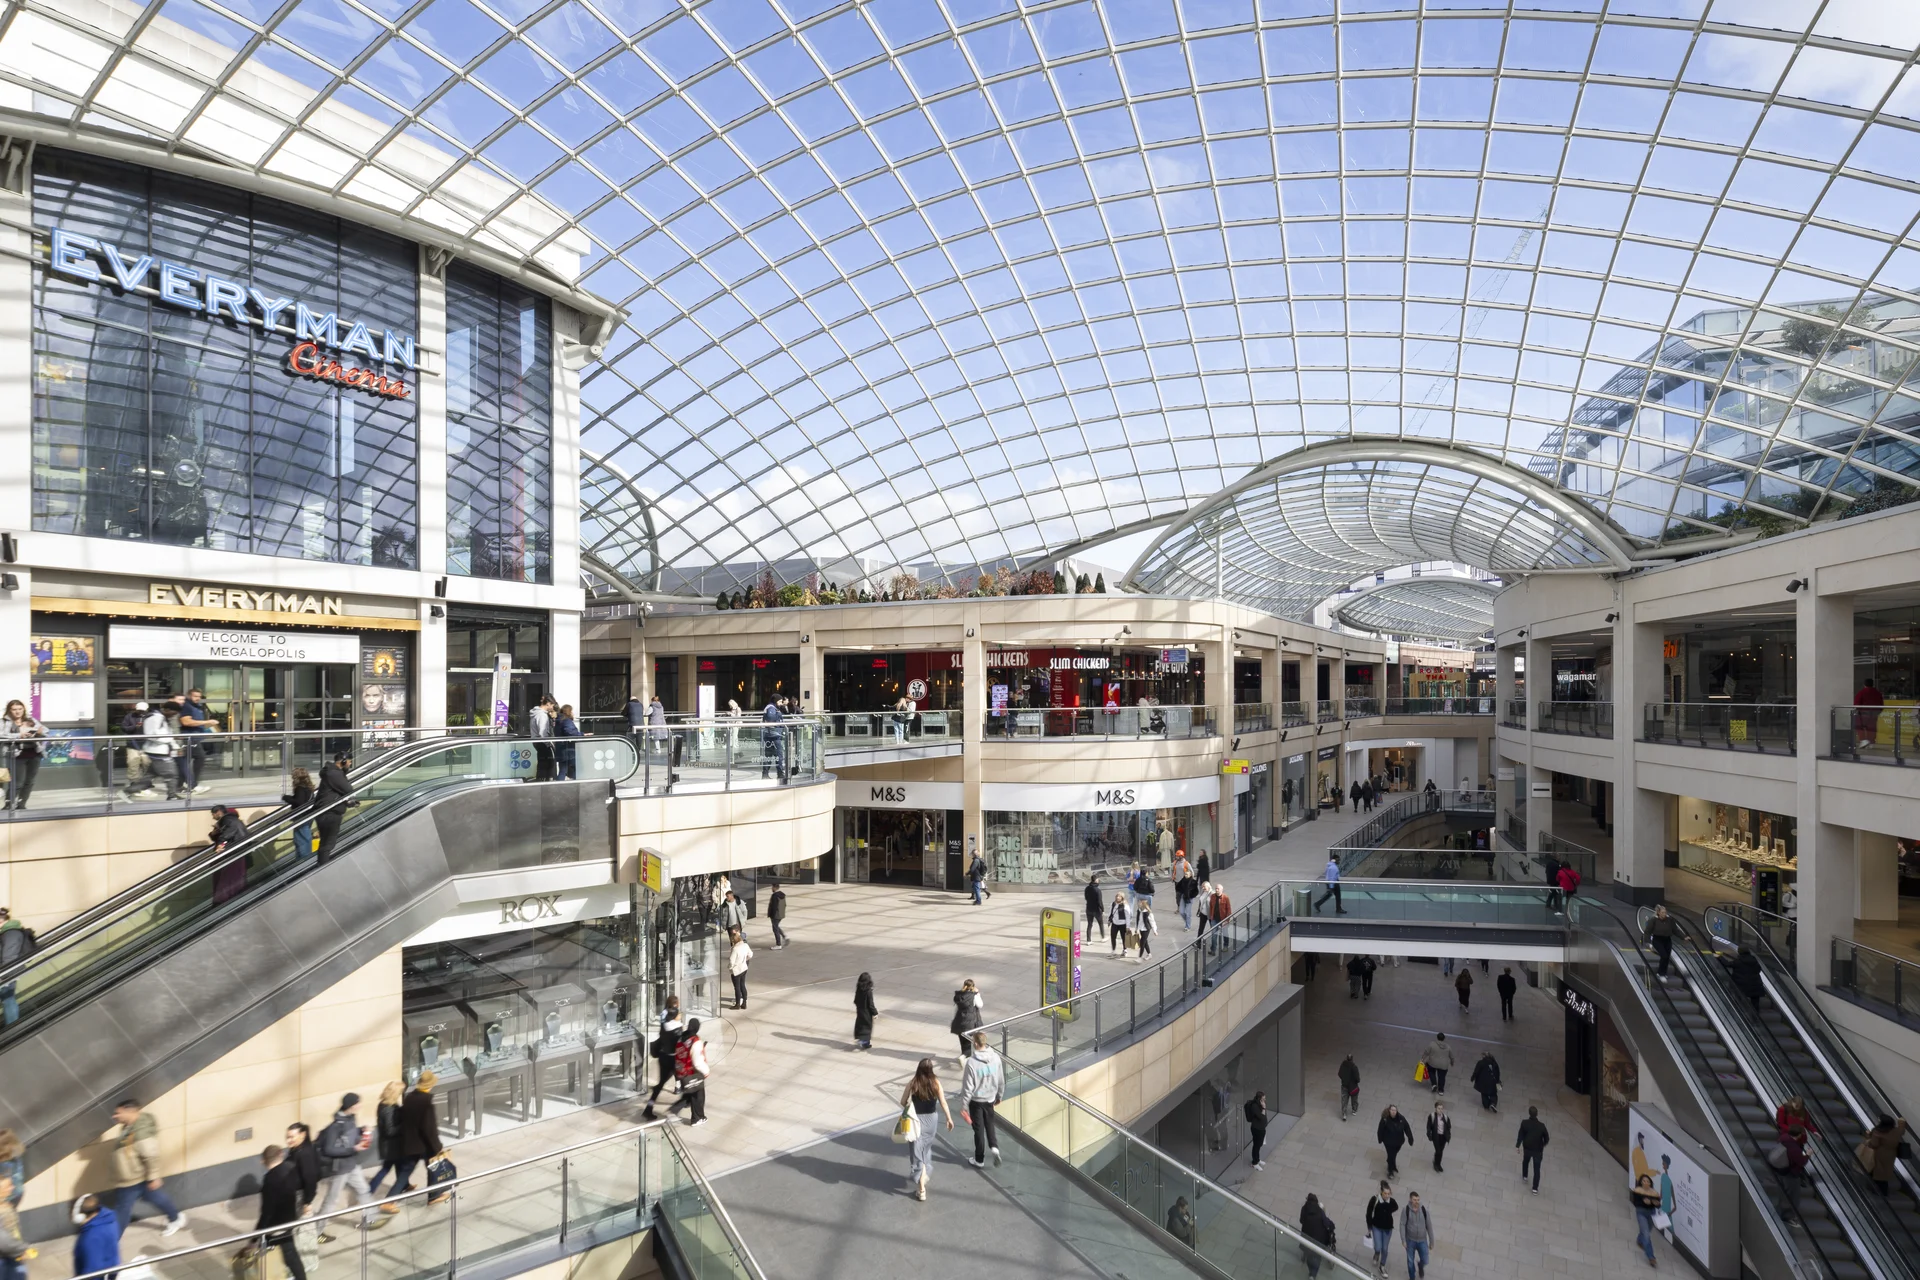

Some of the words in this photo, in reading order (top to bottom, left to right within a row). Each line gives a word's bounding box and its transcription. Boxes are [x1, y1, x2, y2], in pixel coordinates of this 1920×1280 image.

[51, 226, 415, 370] EVERYMAN
[289, 341, 411, 400] Cinema
[148, 582, 343, 616] EVERYMAN
[188, 631, 258, 645] WELCOME
[268, 634, 286, 645] TO
[210, 646, 306, 660] MEGALOPOLIS
[950, 651, 964, 669] SL
[986, 651, 1029, 668] HICKENS
[1049, 657, 1071, 670] SLIM
[1072, 657, 1110, 670] CHICKENS
[1170, 662, 1189, 674] GUYS
[871, 786, 906, 802] M&S
[1097, 789, 1135, 806] M&S
[998, 836, 1021, 851] BIG
[498, 894, 563, 925] ROX
[554, 997, 571, 1007] ROX
[495, 1009, 513, 1019] ROX
[427, 1022, 448, 1033] ROX
